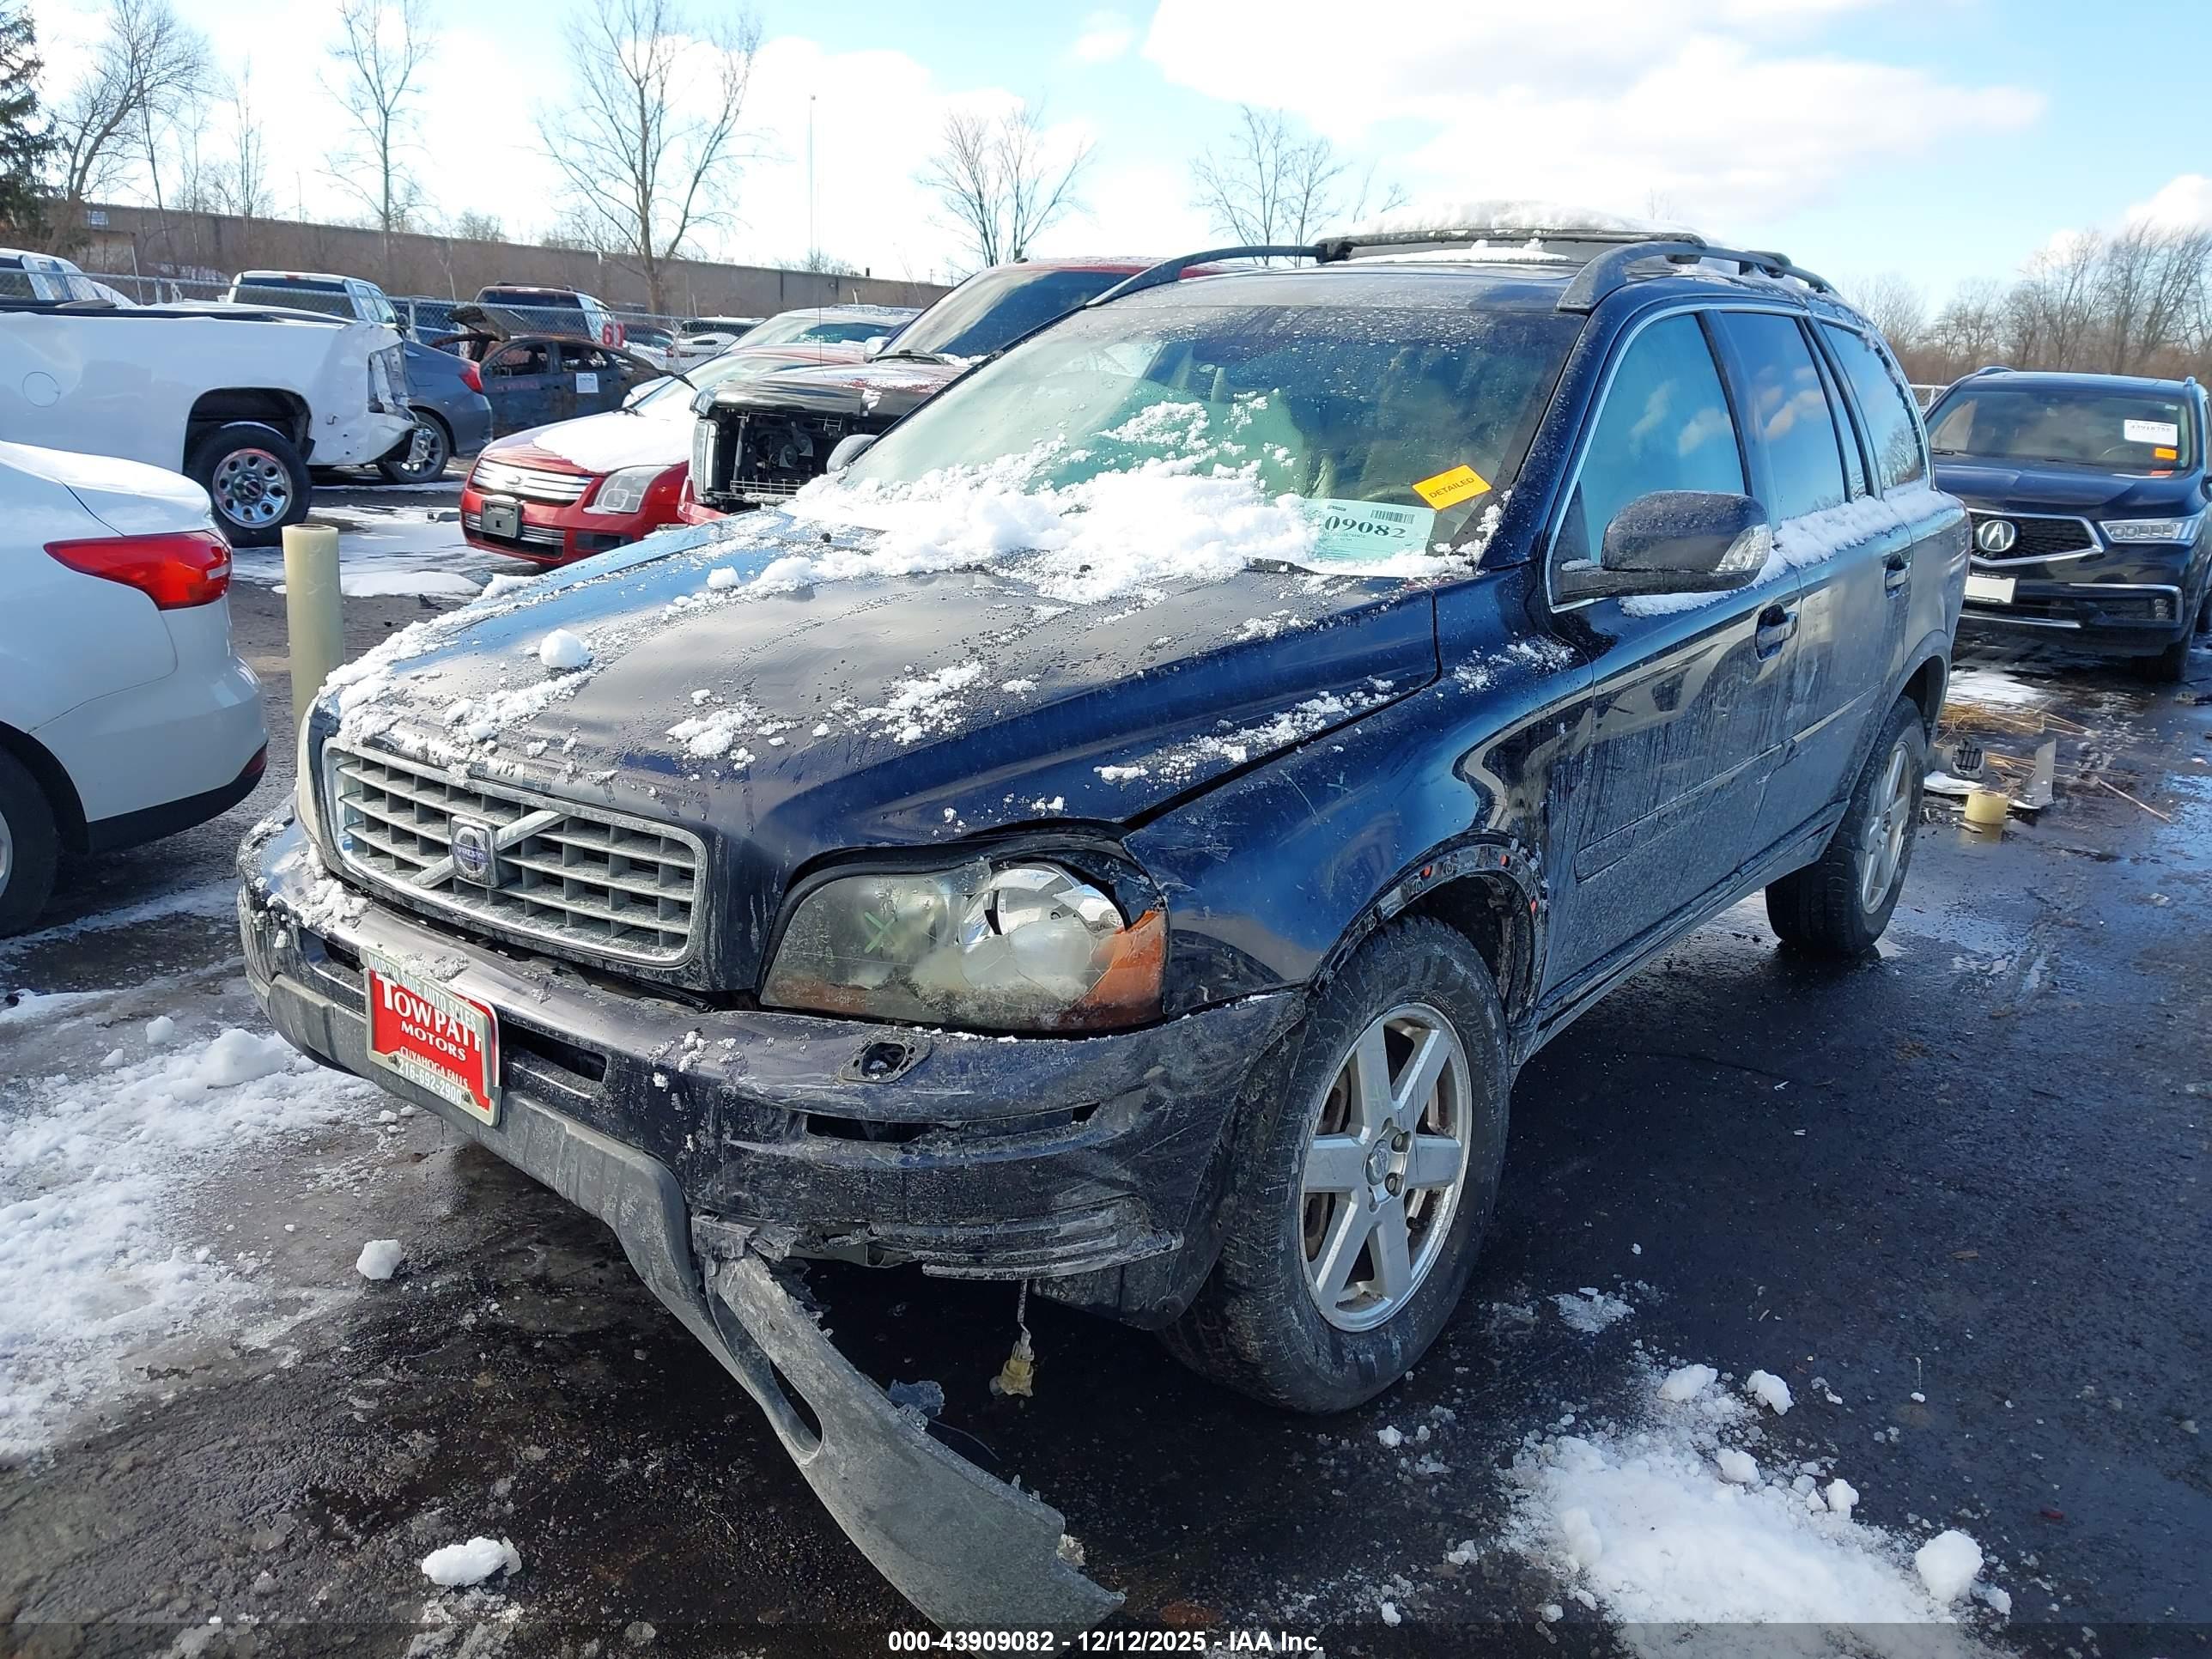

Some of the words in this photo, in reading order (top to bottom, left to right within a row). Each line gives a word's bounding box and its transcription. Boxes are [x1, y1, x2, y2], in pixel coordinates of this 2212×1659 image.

[1428, 477, 1475, 499] DETAILED
[1324, 515, 1407, 538] 09082
[457, 846, 484, 860] VOLVO
[367, 952, 400, 984] NORTH
[401, 969, 422, 997] SIDE
[423, 985, 447, 1013] AUTO
[400, 1021, 467, 1061] MOTORS
[400, 1046, 446, 1078] CUYAHOGA
[398, 1058, 462, 1105] 216-692-2900
